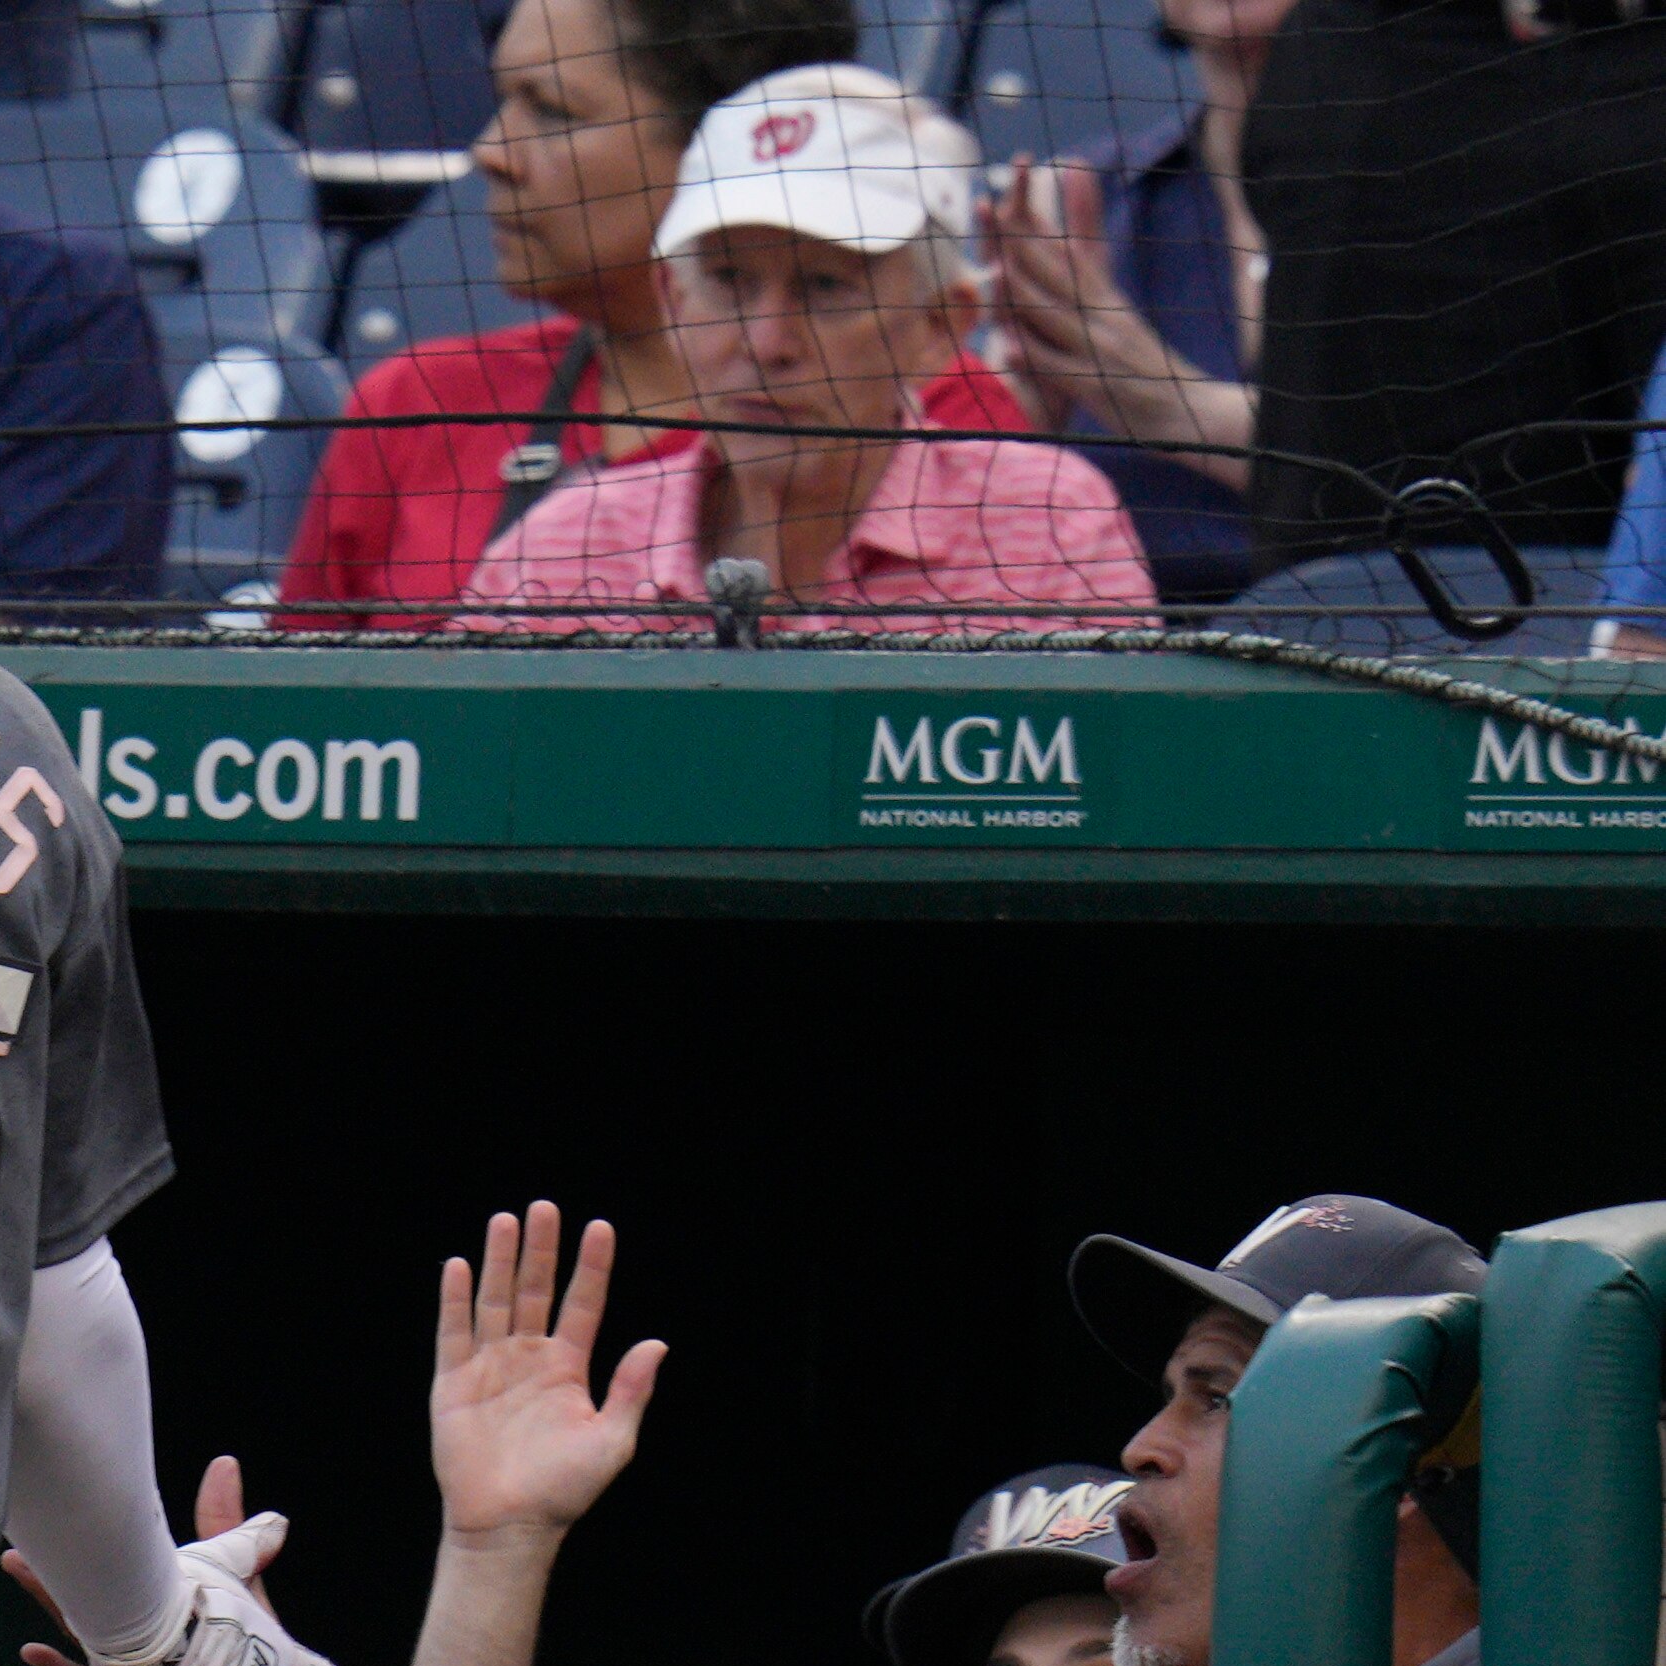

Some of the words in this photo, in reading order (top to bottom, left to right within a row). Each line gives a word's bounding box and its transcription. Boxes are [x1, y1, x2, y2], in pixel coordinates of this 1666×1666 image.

[863, 715, 1083, 785] MGM
[859, 809, 977, 828] NATIONAL
[982, 809, 1082, 828] HARBOR
[1465, 810, 1585, 829] NATIONAL
